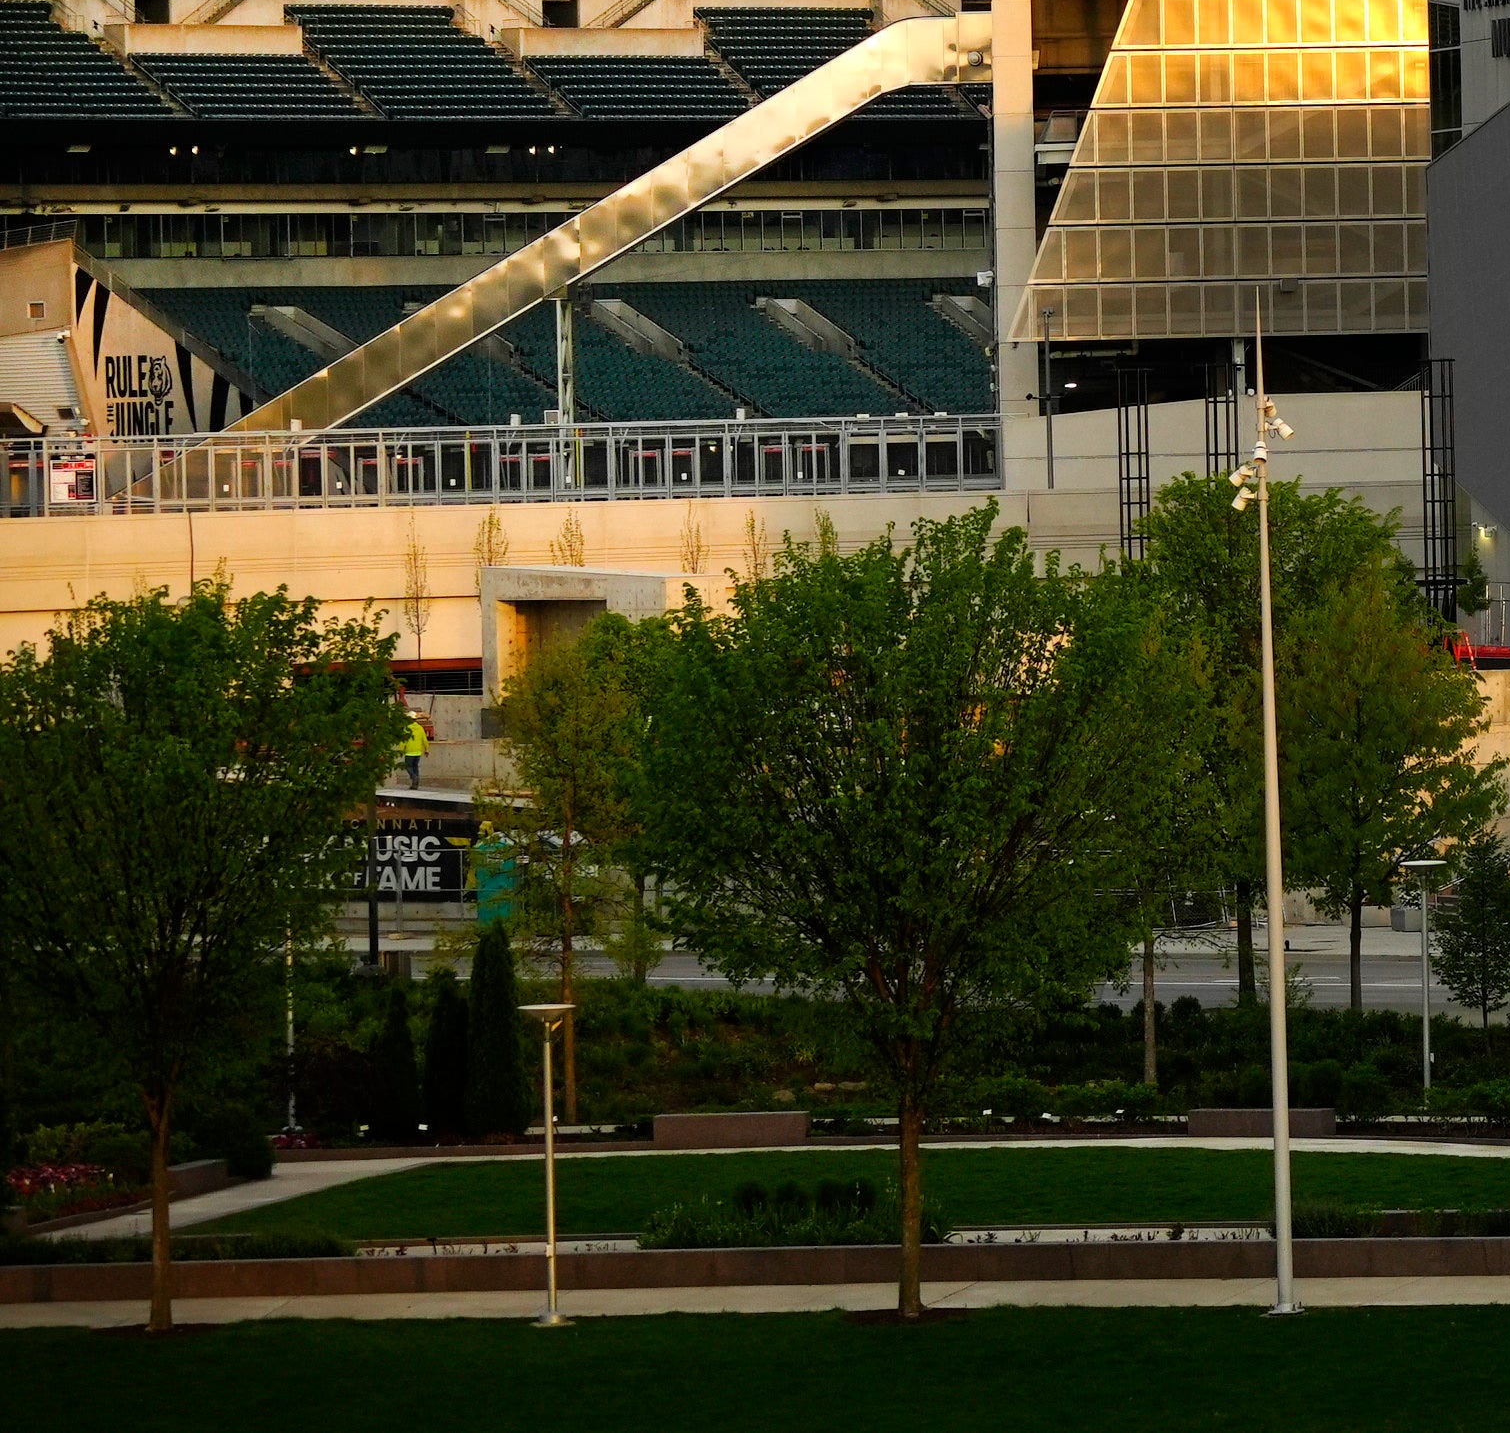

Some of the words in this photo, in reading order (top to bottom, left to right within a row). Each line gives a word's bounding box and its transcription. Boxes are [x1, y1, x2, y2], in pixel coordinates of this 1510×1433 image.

[105, 355, 148, 399] RULE
[110, 401, 174, 443] JUNGLE
[365, 835, 442, 863] USIC
